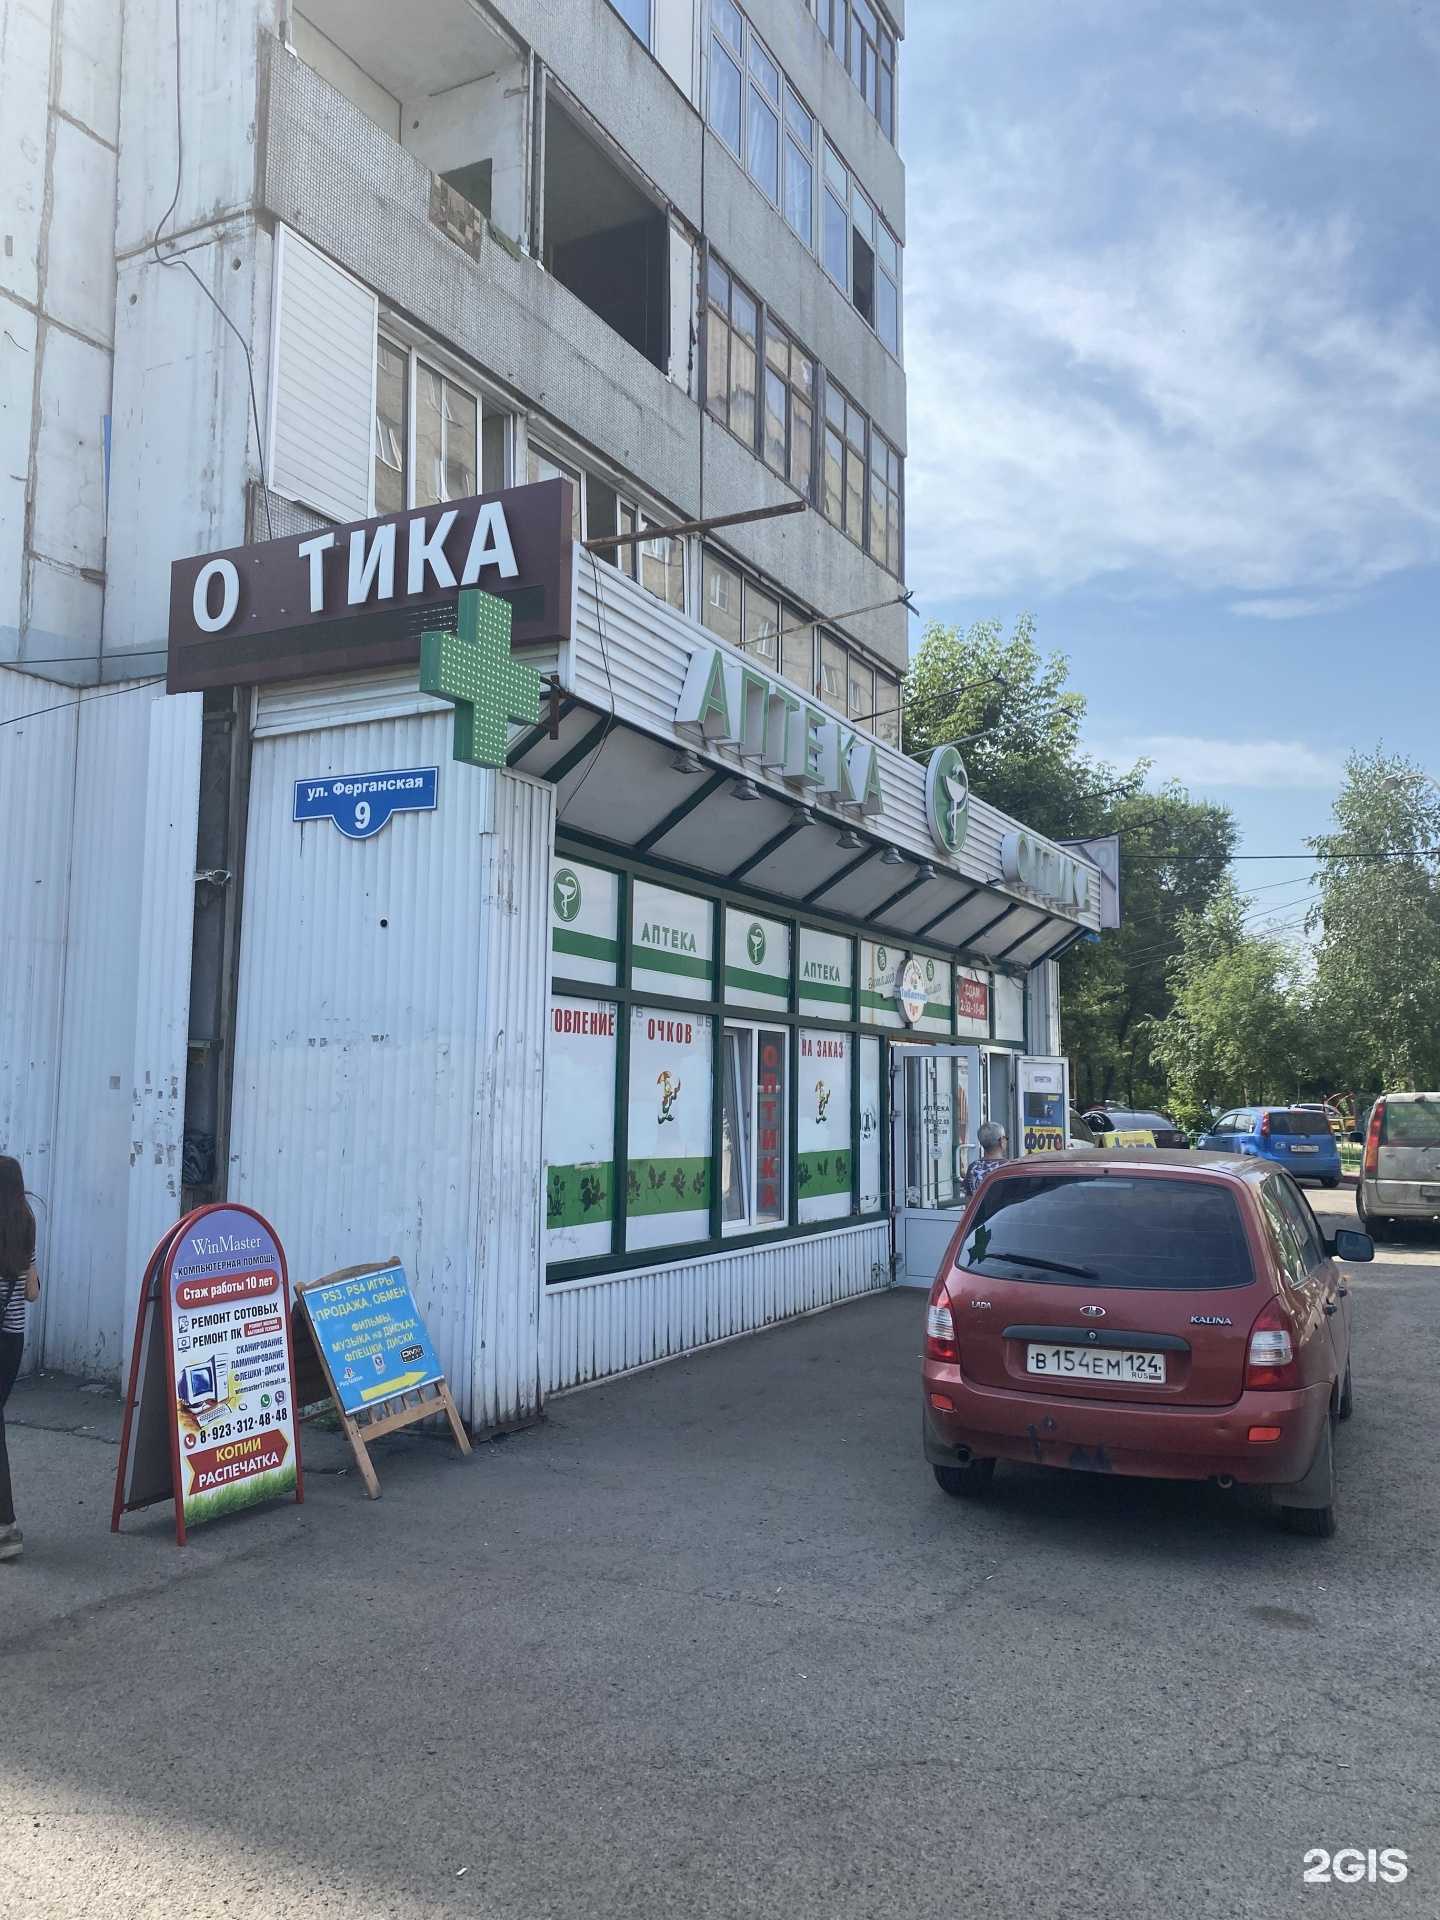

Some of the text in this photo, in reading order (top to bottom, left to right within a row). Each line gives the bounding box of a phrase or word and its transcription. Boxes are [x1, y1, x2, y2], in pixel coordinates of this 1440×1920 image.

[684, 649, 884, 815] АПТЕКА
[308, 777, 424, 801] ул. Ферганская
[354, 801, 371, 829] 9
[641, 922, 697, 953] АПТЕКА
[803, 961, 841, 982] АПТЕКА
[647, 1018, 693, 1044] ОЧКОВ
[801, 1040, 844, 1058] НА ЗАКАЗ
[192, 1235, 262, 1255] WinMaster
[178, 1254, 275, 1276] КОМПЬЮТЕРНАЯ ПОМОЩЬ
[183, 1276, 273, 1300] Стаж работы 10 лет
[346, 1284, 366, 1297] PS4
[366, 1275, 394, 1291] ИГРЫ
[372, 1286, 407, 1304] ОБМЕН
[191, 1302, 278, 1329] РЕМОНТ СОТОВЫХ
[1190, 1315, 1233, 1326] KALINA
[192, 1328, 242, 1348] РЕМОНТ ПК
[236, 1337, 283, 1355] СКАНИРОВАНИЕ
[331, 1333, 371, 1352] МУЗЫКА
[231, 1350, 284, 1369] ЛАМИНИРОВАНИЕ
[1125, 1354, 1158, 1373] 124
[234, 1362, 285, 1381] ФЛЕШКИ ДИСКИ
[1131, 1371, 1149, 1379] RUS
[216, 1438, 261, 1462] КОПИИ
[198, 1451, 280, 1487] РАСПЕЧАТКА
